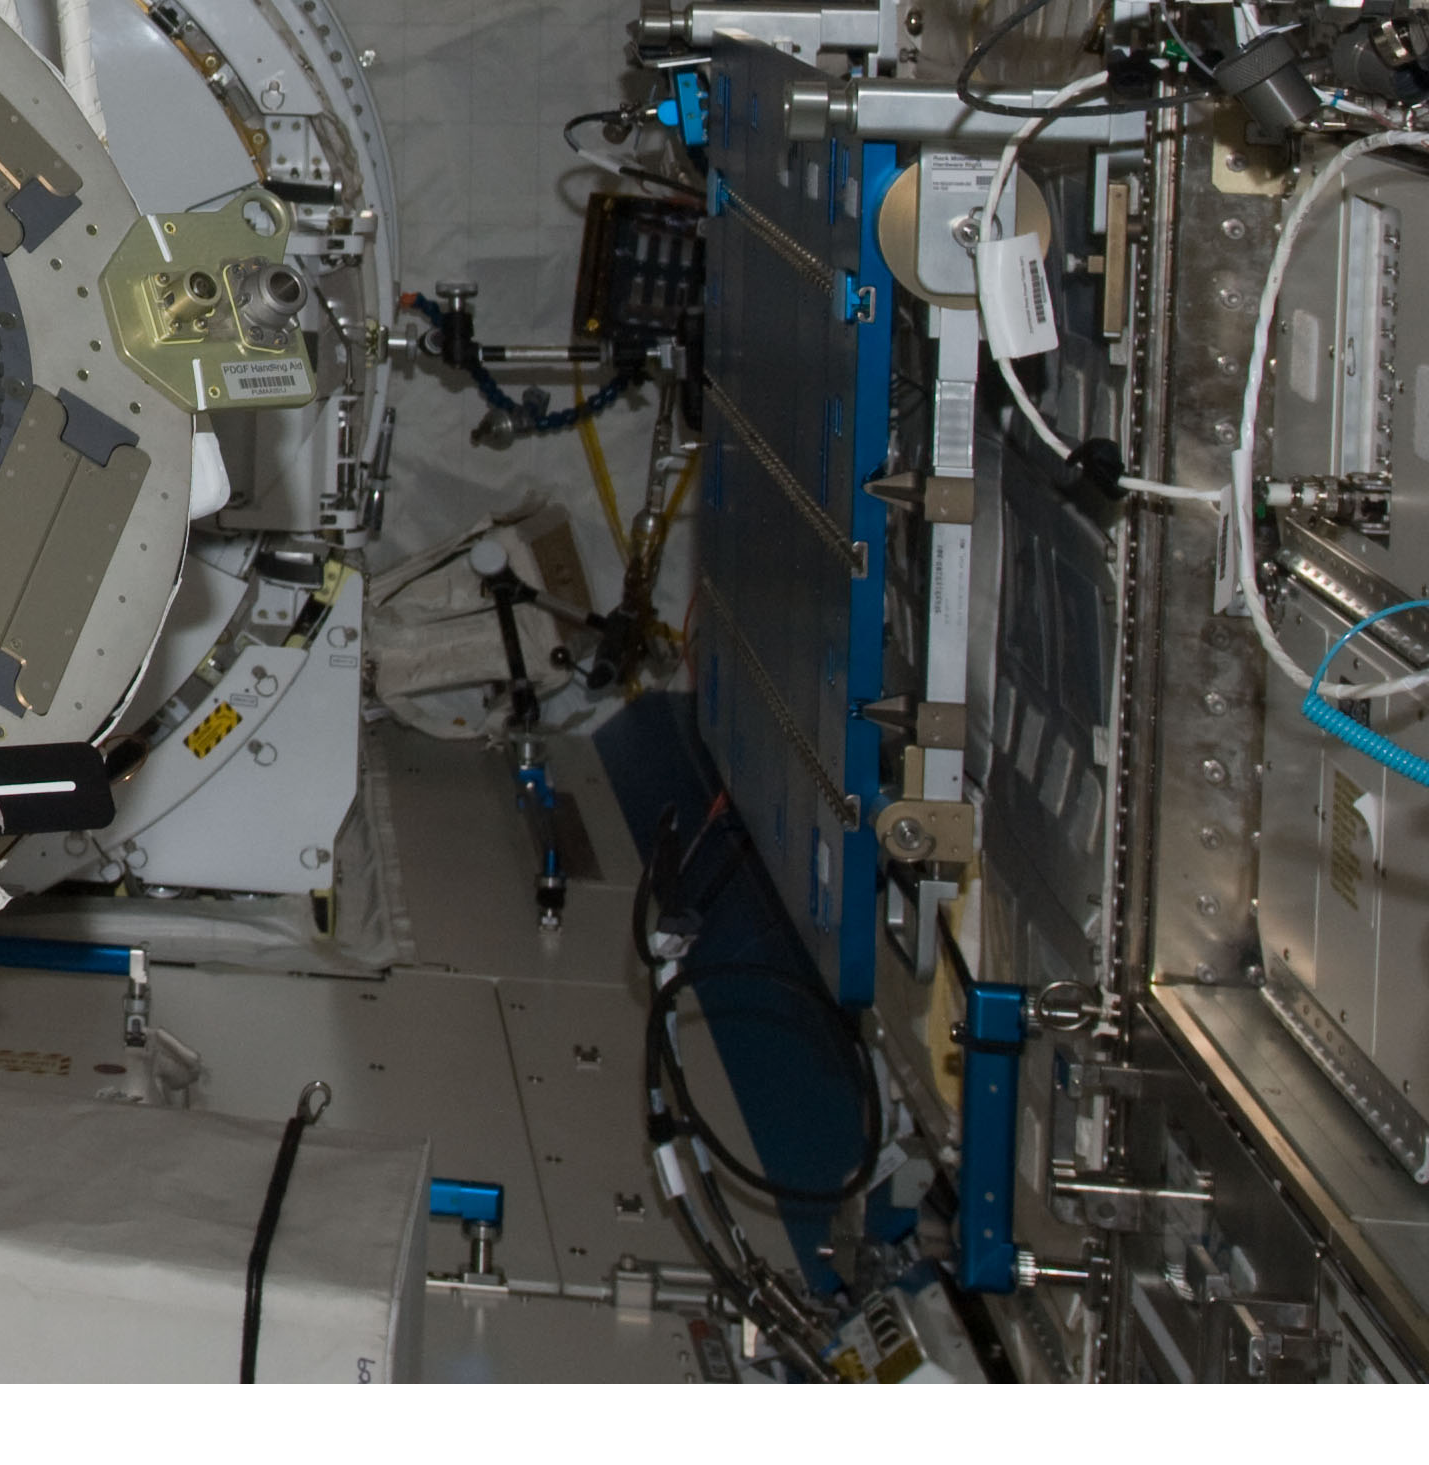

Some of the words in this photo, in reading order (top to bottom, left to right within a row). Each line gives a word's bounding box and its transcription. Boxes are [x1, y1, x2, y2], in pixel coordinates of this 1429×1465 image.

[223, 365, 249, 375] PDGF
[251, 363, 288, 373] Handling
[289, 361, 303, 370] Aid
